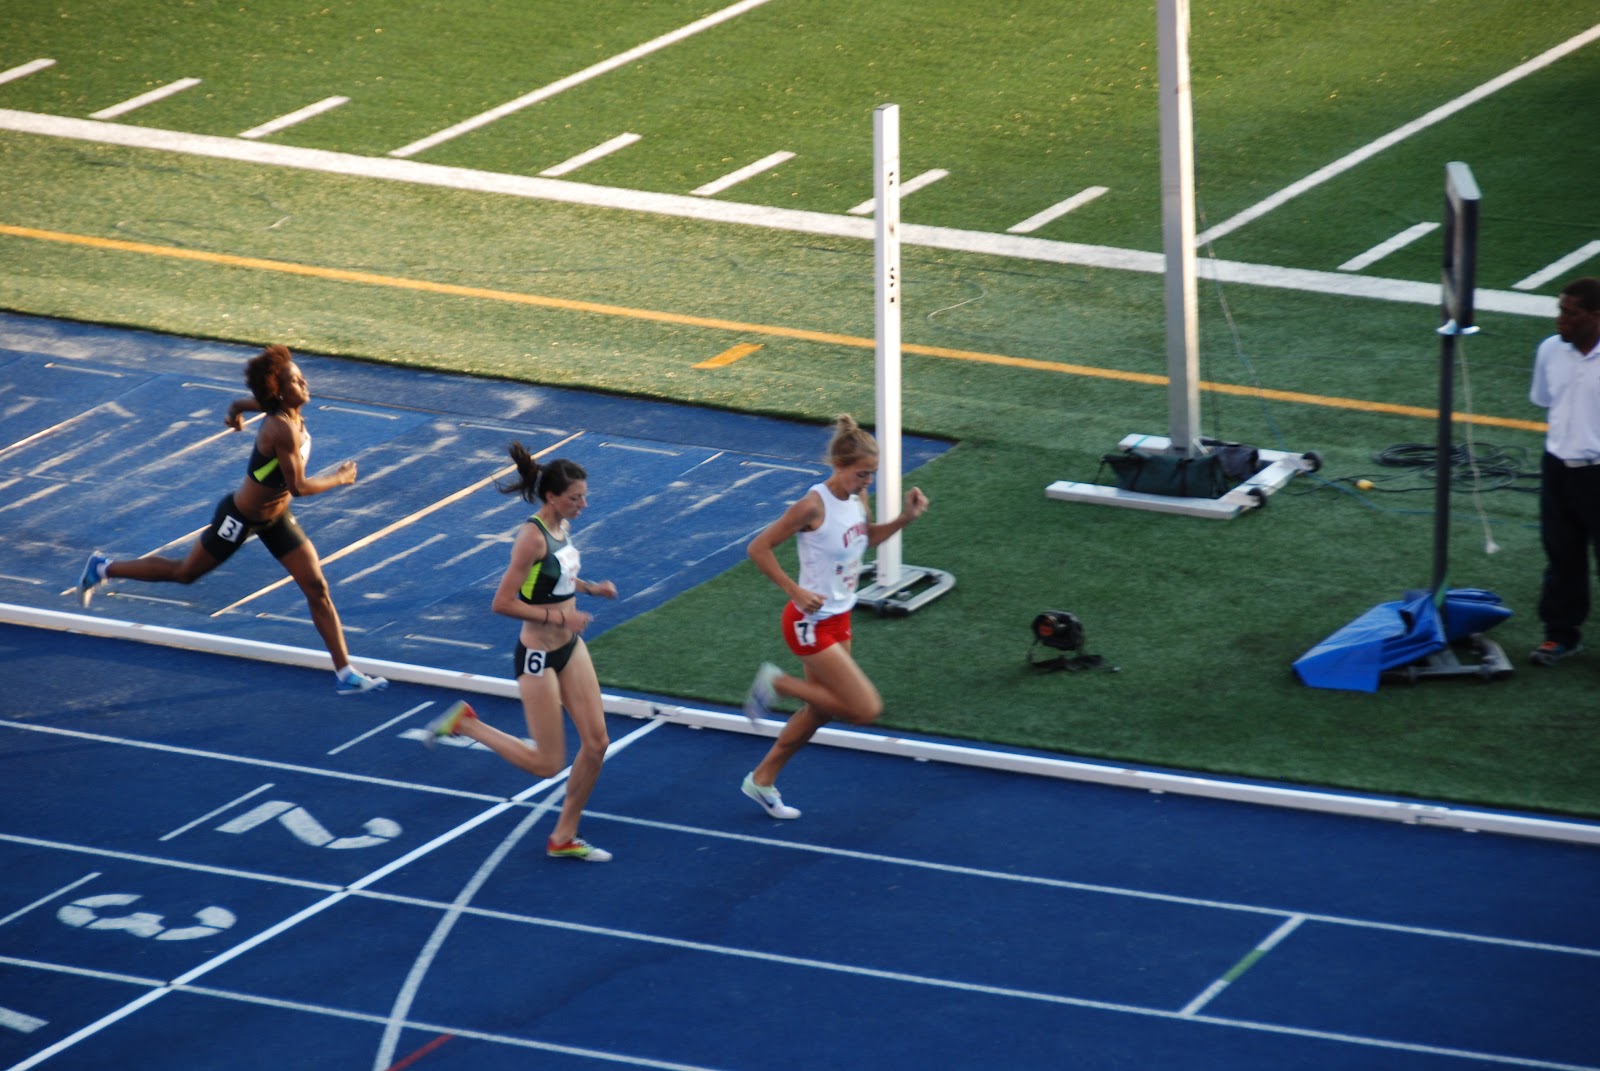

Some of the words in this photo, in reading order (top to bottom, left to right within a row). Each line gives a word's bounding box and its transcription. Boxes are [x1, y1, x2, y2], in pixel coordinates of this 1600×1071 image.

[221, 519, 237, 539] 3
[797, 622, 808, 644] 7
[527, 651, 543, 674] 6
[214, 800, 403, 850] 2
[56, 893, 237, 941] 3
